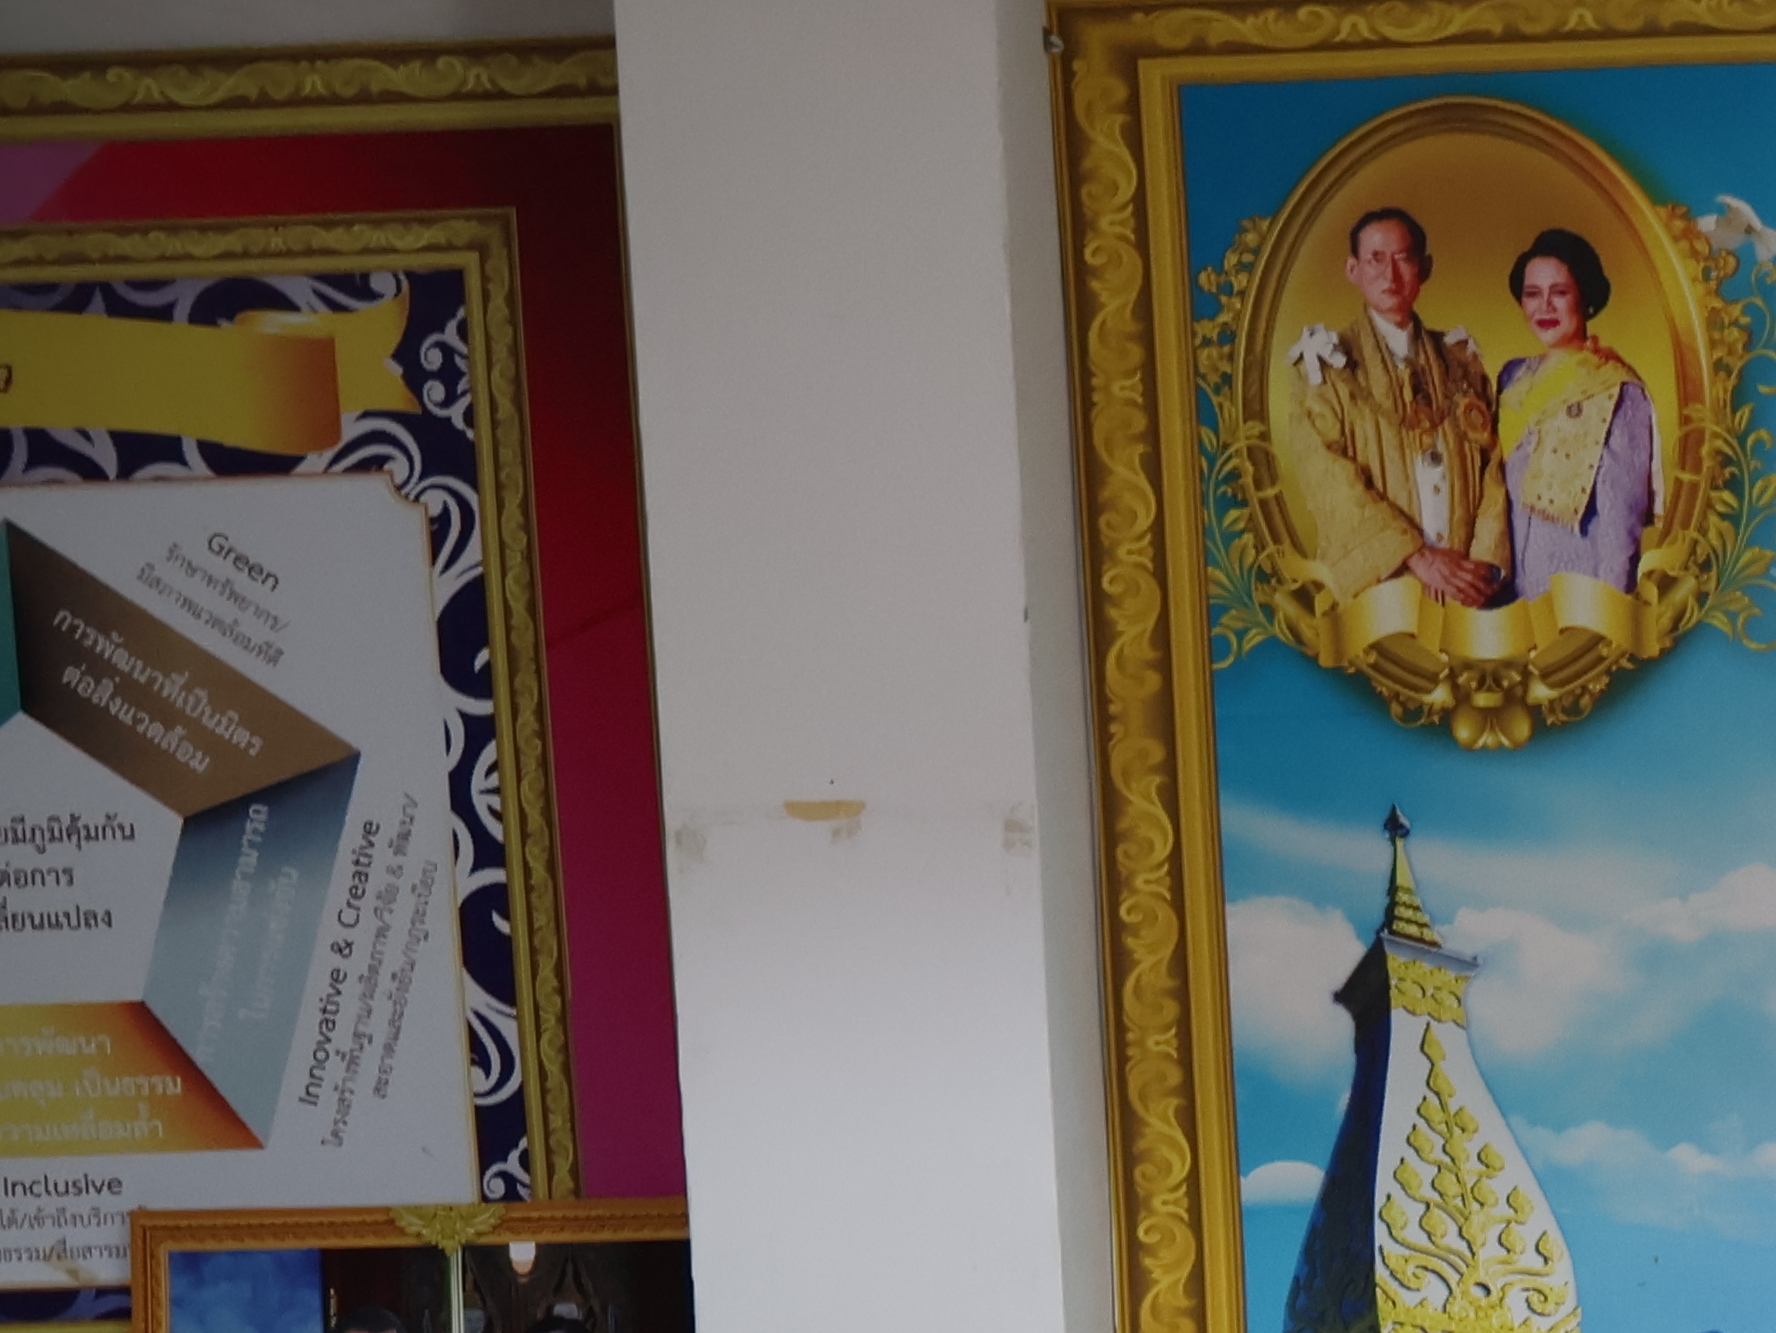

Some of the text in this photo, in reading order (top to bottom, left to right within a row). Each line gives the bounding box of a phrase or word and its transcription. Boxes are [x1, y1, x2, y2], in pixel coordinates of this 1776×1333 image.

[206, 531, 281, 593] Green
[297, 960, 353, 1107] Innovative
[337, 818, 381, 930] Creative
[3, 1172, 123, 1198] Inclusive
